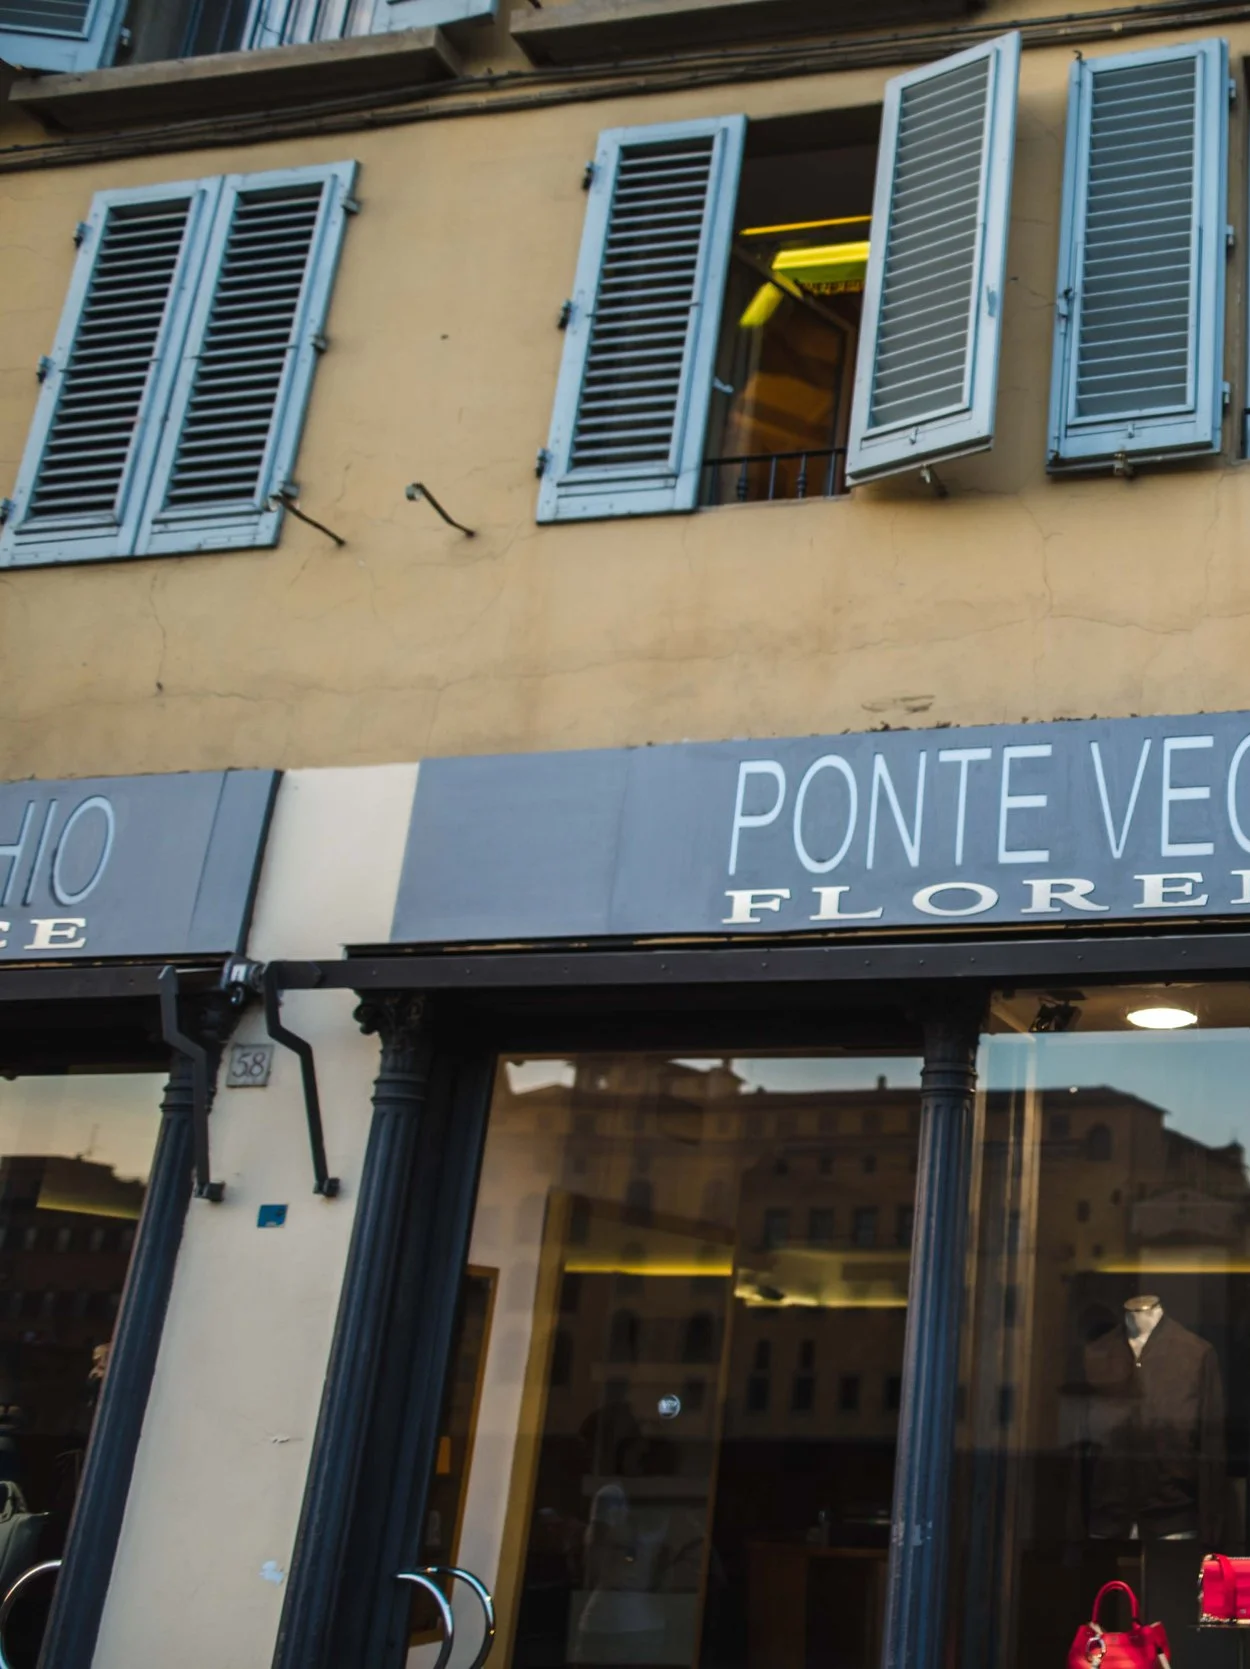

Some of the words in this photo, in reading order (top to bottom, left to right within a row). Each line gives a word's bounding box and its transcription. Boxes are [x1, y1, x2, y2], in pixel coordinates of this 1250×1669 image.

[728, 743, 1053, 876] PONTE
[0, 917, 87, 950] E
[232, 1052, 266, 1078] 58
